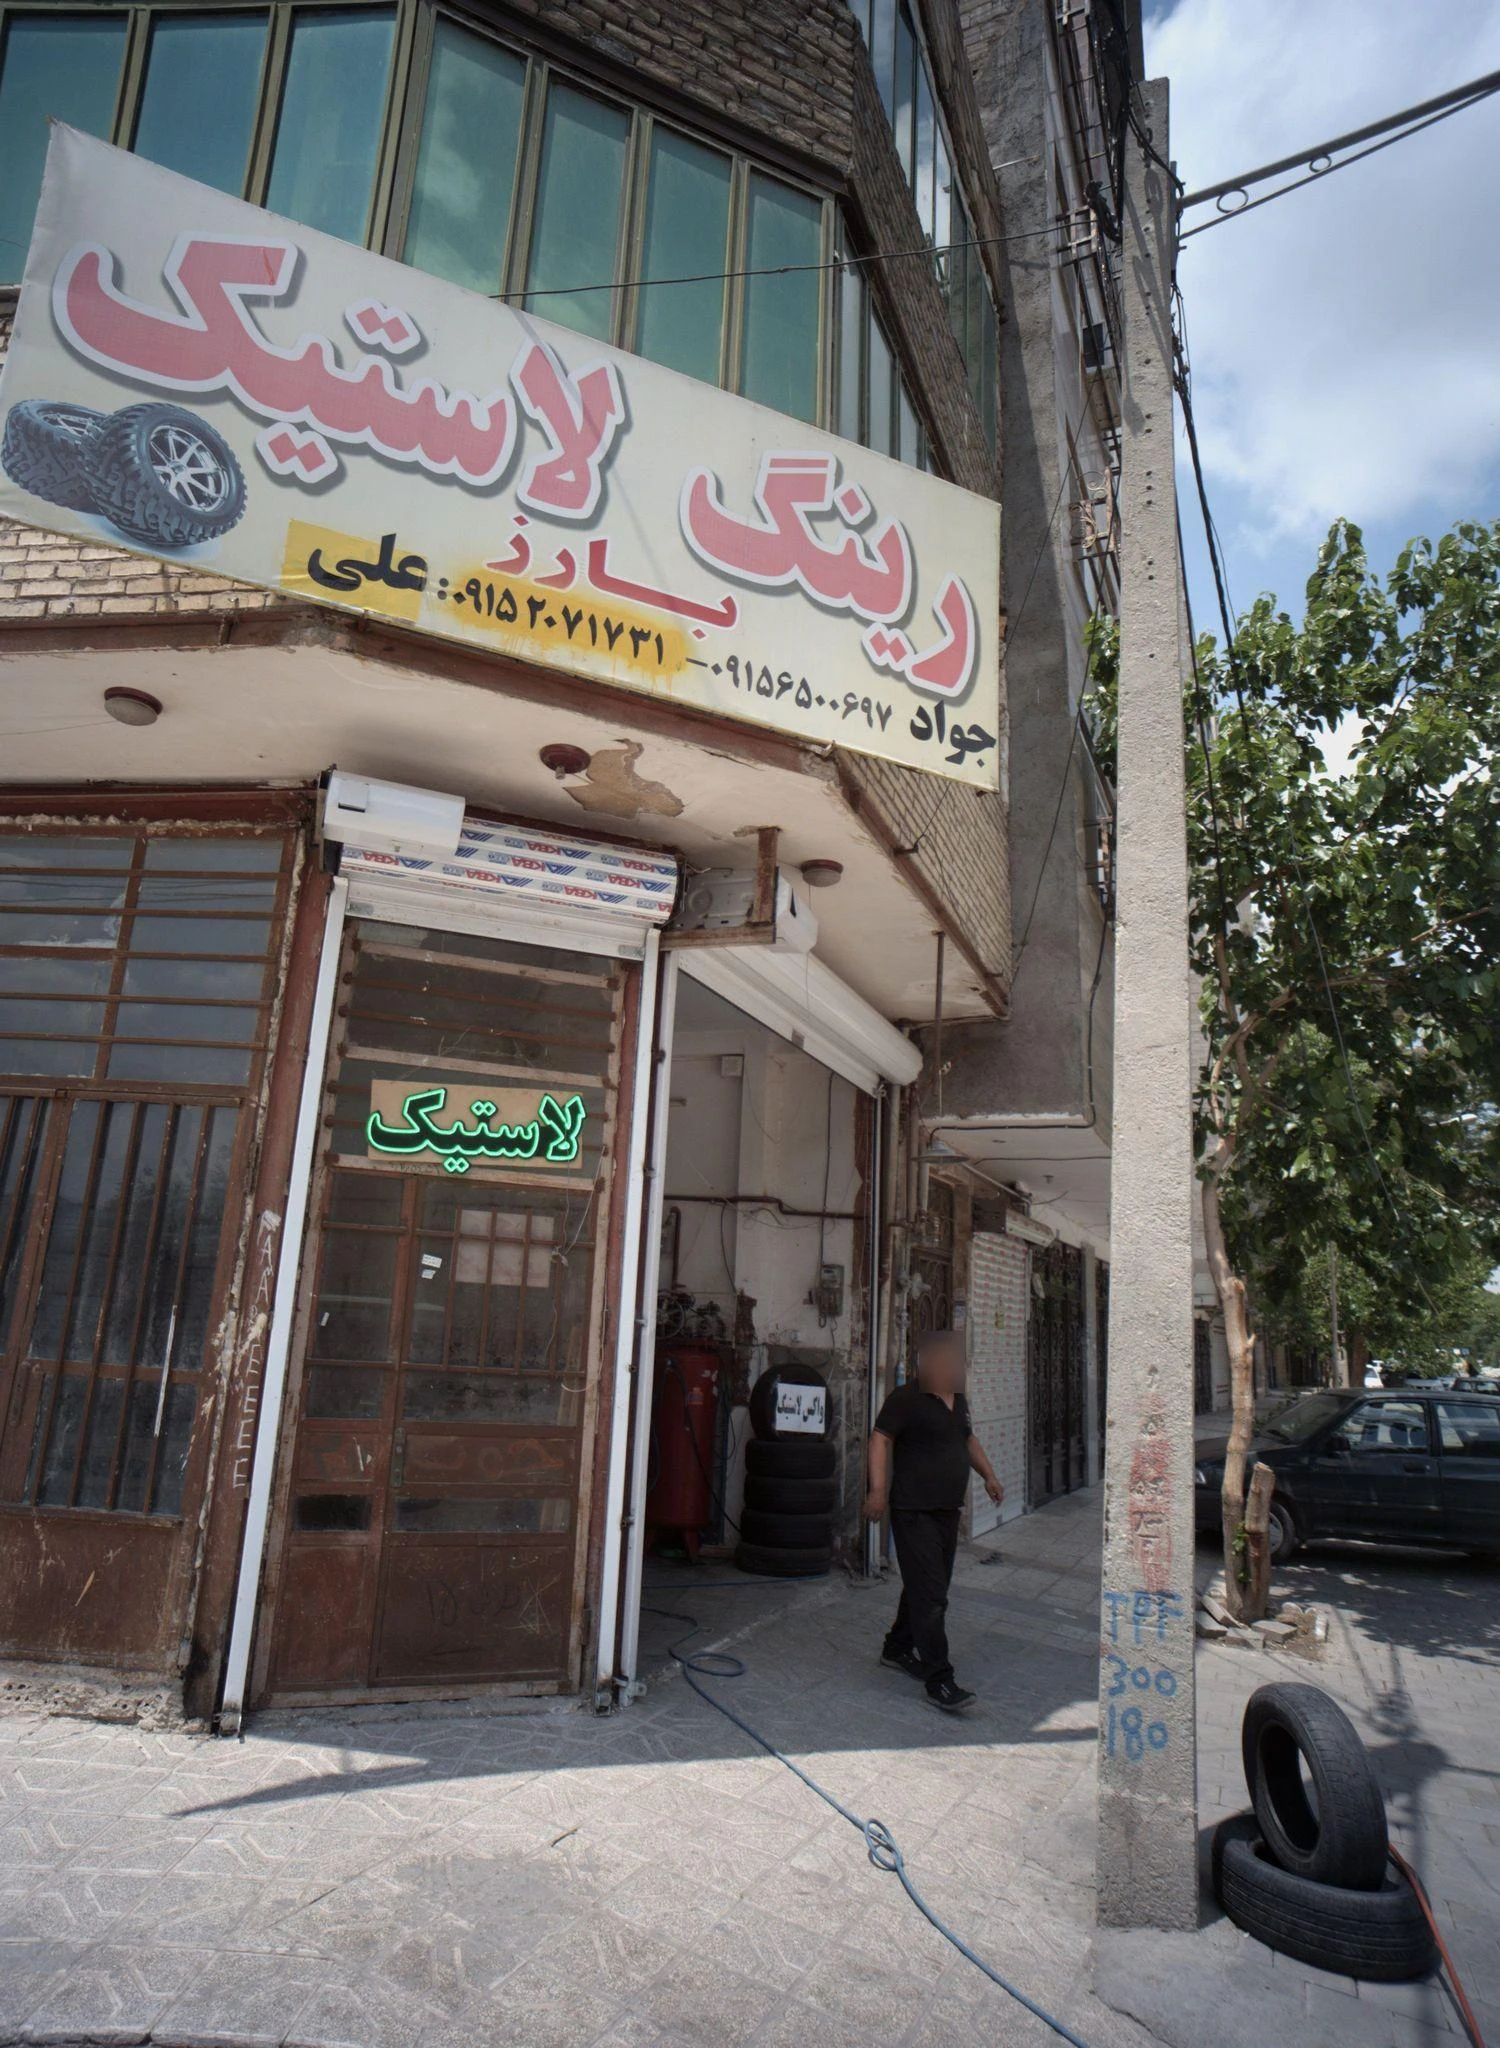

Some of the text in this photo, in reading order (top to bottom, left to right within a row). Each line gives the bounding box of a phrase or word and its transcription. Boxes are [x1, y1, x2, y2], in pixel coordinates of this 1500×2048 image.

[58, 235, 975, 696] رینگ لاستیک
[308, 532, 428, 592] علی
[909, 699, 997, 768] جواد
[366, 1088, 586, 1174] لاستیک
[1107, 1654, 1178, 1697] 300
[1106, 1703, 1170, 1762] 180
